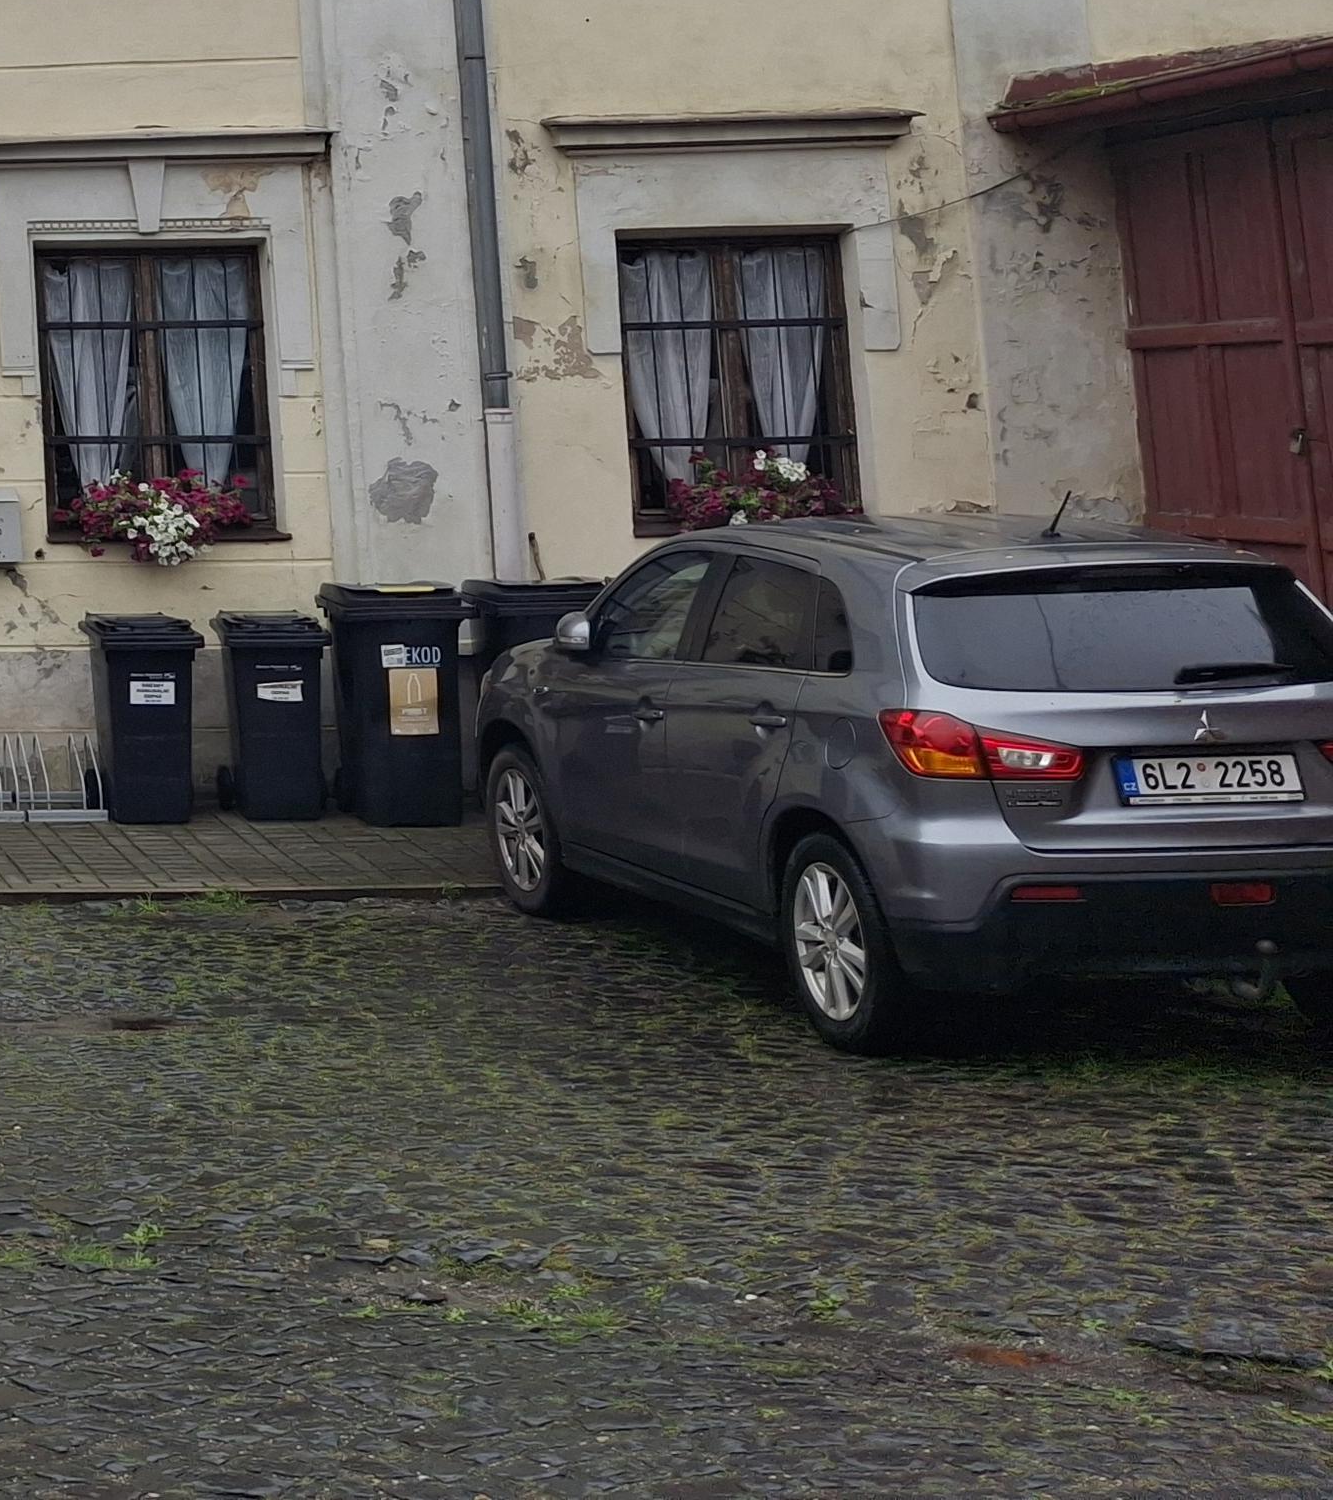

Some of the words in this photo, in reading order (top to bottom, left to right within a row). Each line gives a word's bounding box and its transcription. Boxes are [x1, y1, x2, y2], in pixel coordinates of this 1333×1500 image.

[1142, 762, 1195, 790] 6L2
[1214, 760, 1285, 788] 2258
[1123, 782, 1138, 791] CZ
